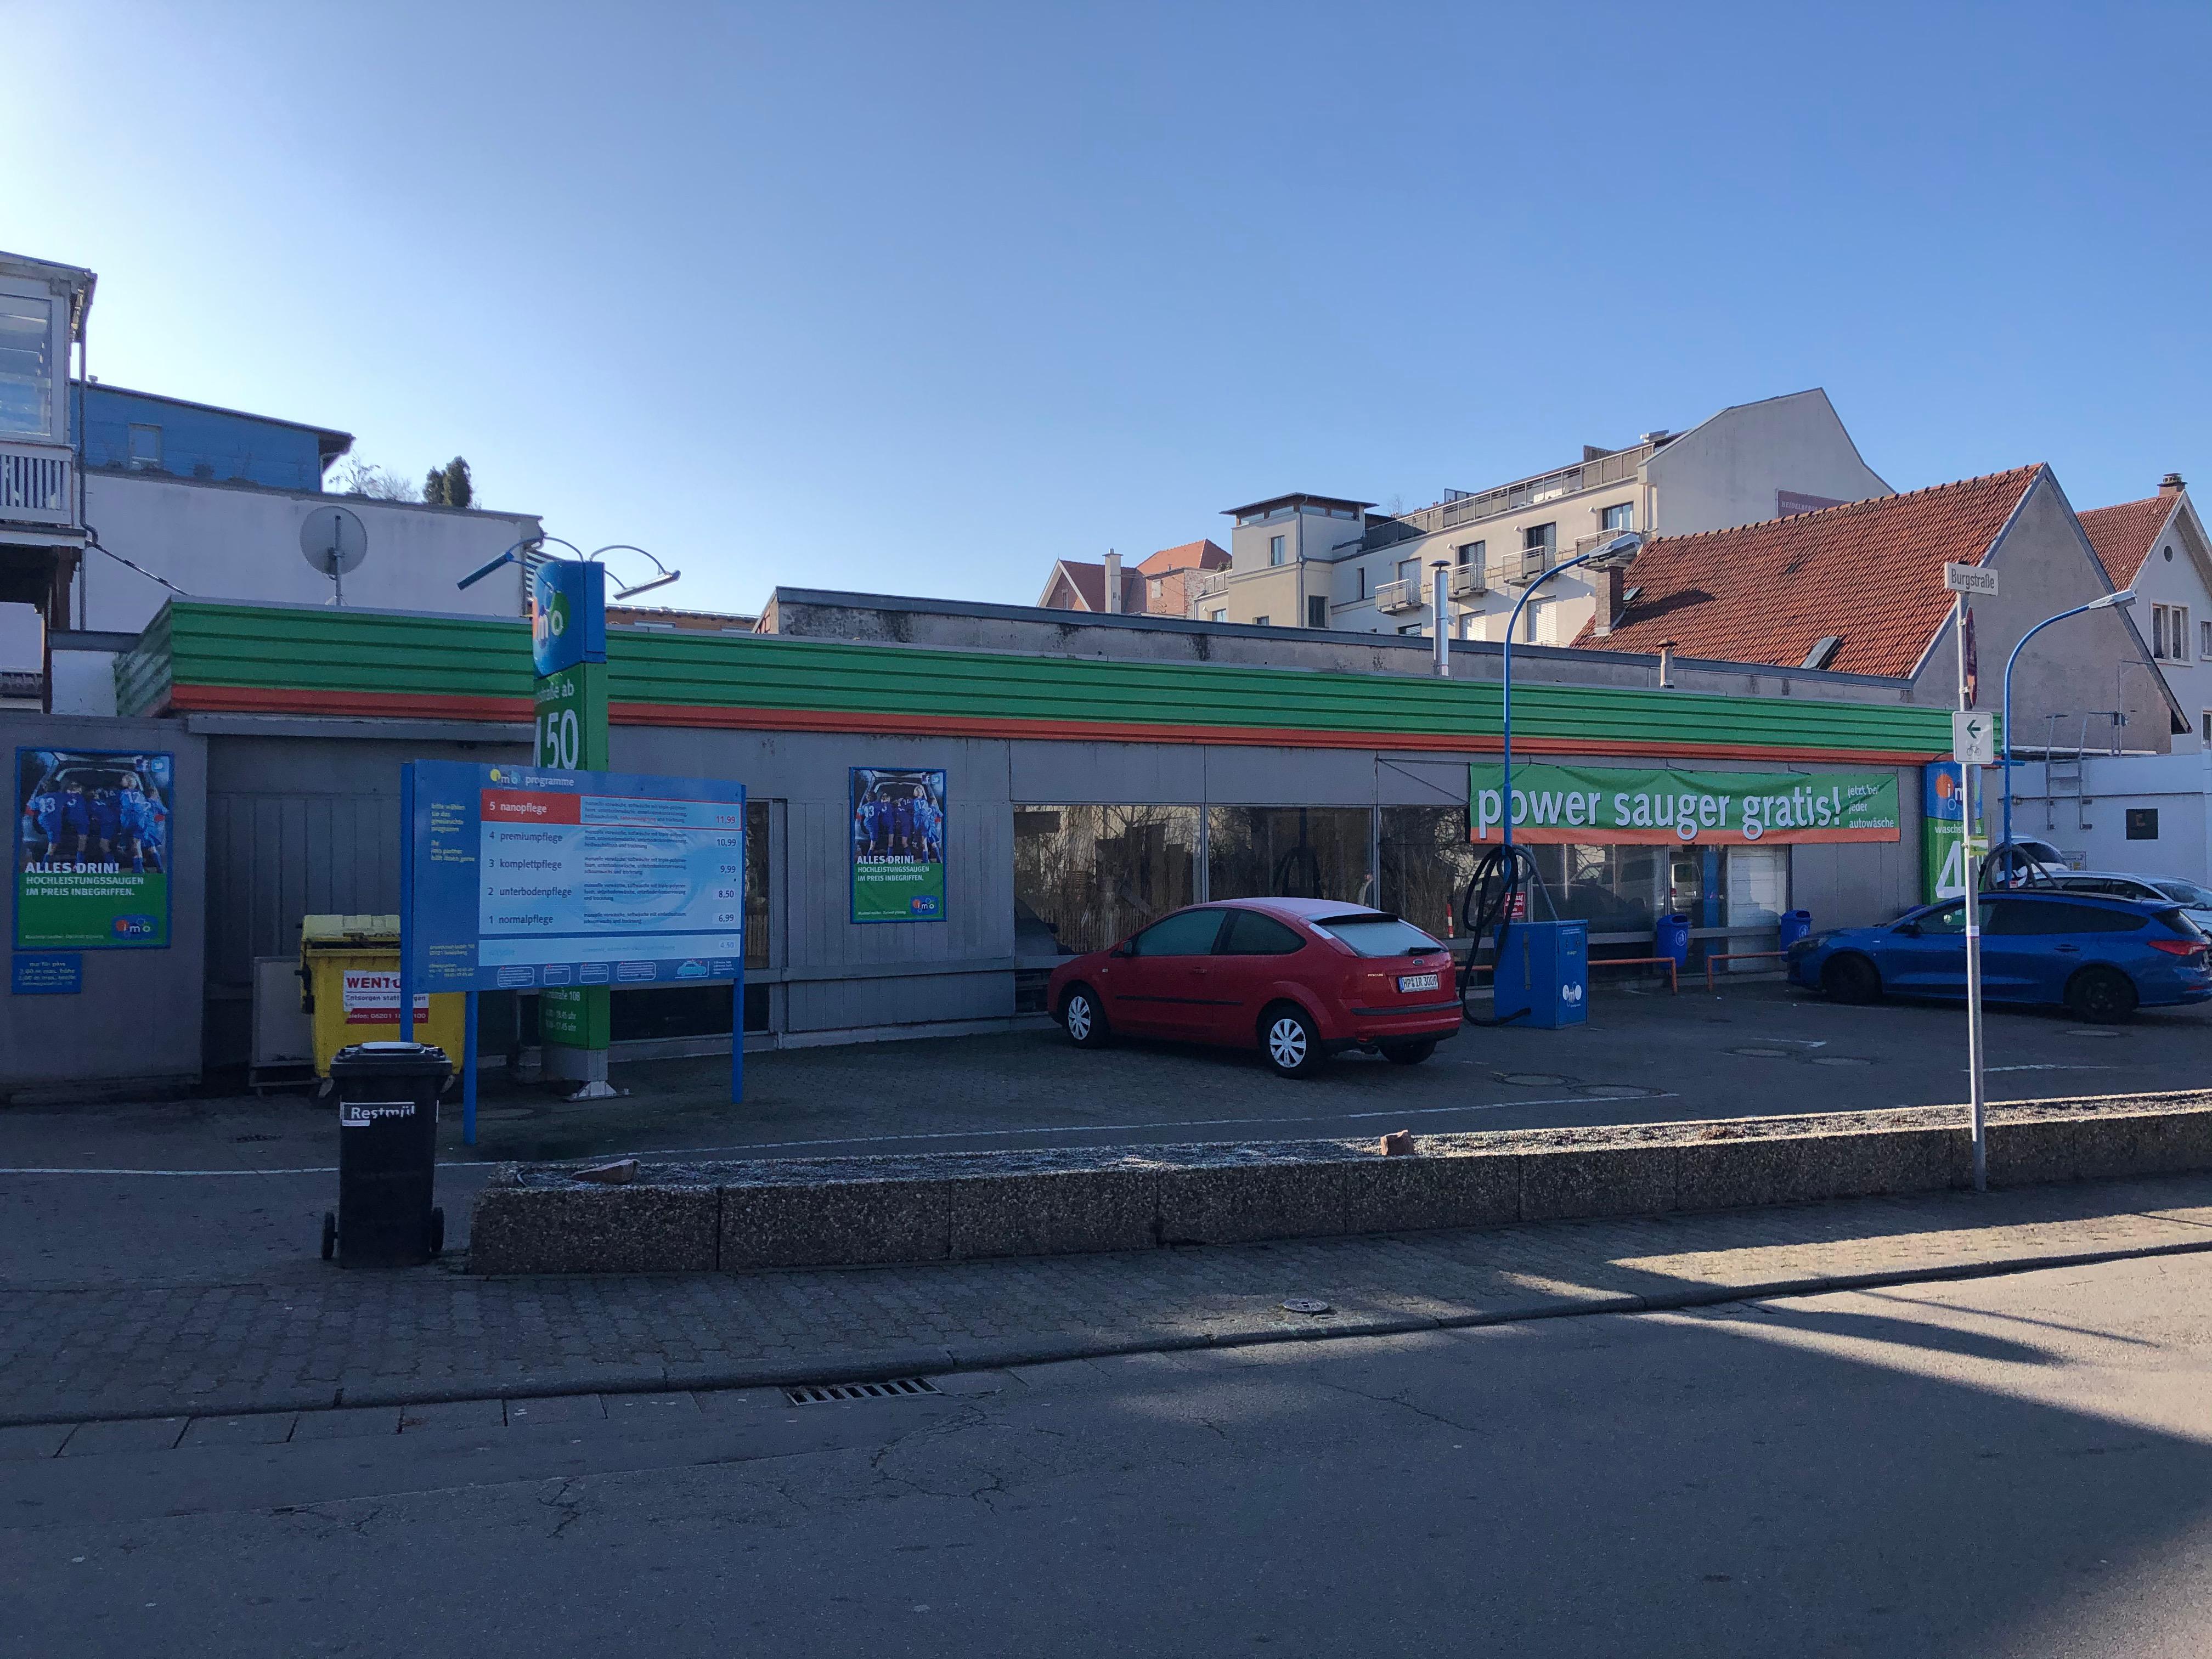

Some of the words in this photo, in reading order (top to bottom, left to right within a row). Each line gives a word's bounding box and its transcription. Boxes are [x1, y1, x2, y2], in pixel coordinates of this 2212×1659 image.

[1951, 568, 1995, 589] Burgstraße
[561, 678, 574, 697] ab
[525, 776, 574, 787] programme
[1848, 785, 1867, 799] jetzt
[1866, 784, 1880, 795] bei
[489, 802, 495, 811] 5
[500, 802, 548, 815] nanopflege
[1479, 789, 1601, 839] power
[1614, 793, 1730, 840] sauger
[1742, 786, 1841, 840] gratis!
[1848, 800, 1867, 815] jeder
[1849, 816, 1894, 828] autowäsche
[489, 831, 495, 839] 4
[500, 832, 563, 844] premiumpflege
[716, 838, 736, 847] 10,99
[488, 859, 495, 868] 3
[499, 858, 562, 871] komplettpflege
[856, 855, 886, 864] ALLES
[888, 855, 915, 864] DRIN!
[25, 862, 72, 874] ALLES
[76, 862, 120, 874] DRIN!
[720, 865, 736, 873] 9,99
[26, 877, 144, 885] HOCHLEISTUNGSSAUGEN
[26, 888, 38, 896] IM
[41, 888, 69, 896] PREIS
[71, 888, 136, 896] INBEGRIFFEN.
[487, 887, 494, 896] 2
[499, 886, 572, 899] unterbodenpflege
[718, 889, 735, 899] 8,50
[488, 915, 494, 924] 1
[498, 914, 554, 926] normalpflege
[718, 914, 734, 923] 6,99
[122, 923, 151, 933] imo
[1403, 978, 1411, 988] HP
[1424, 975, 1437, 986] 3009
[569, 991, 580, 1001] 108
